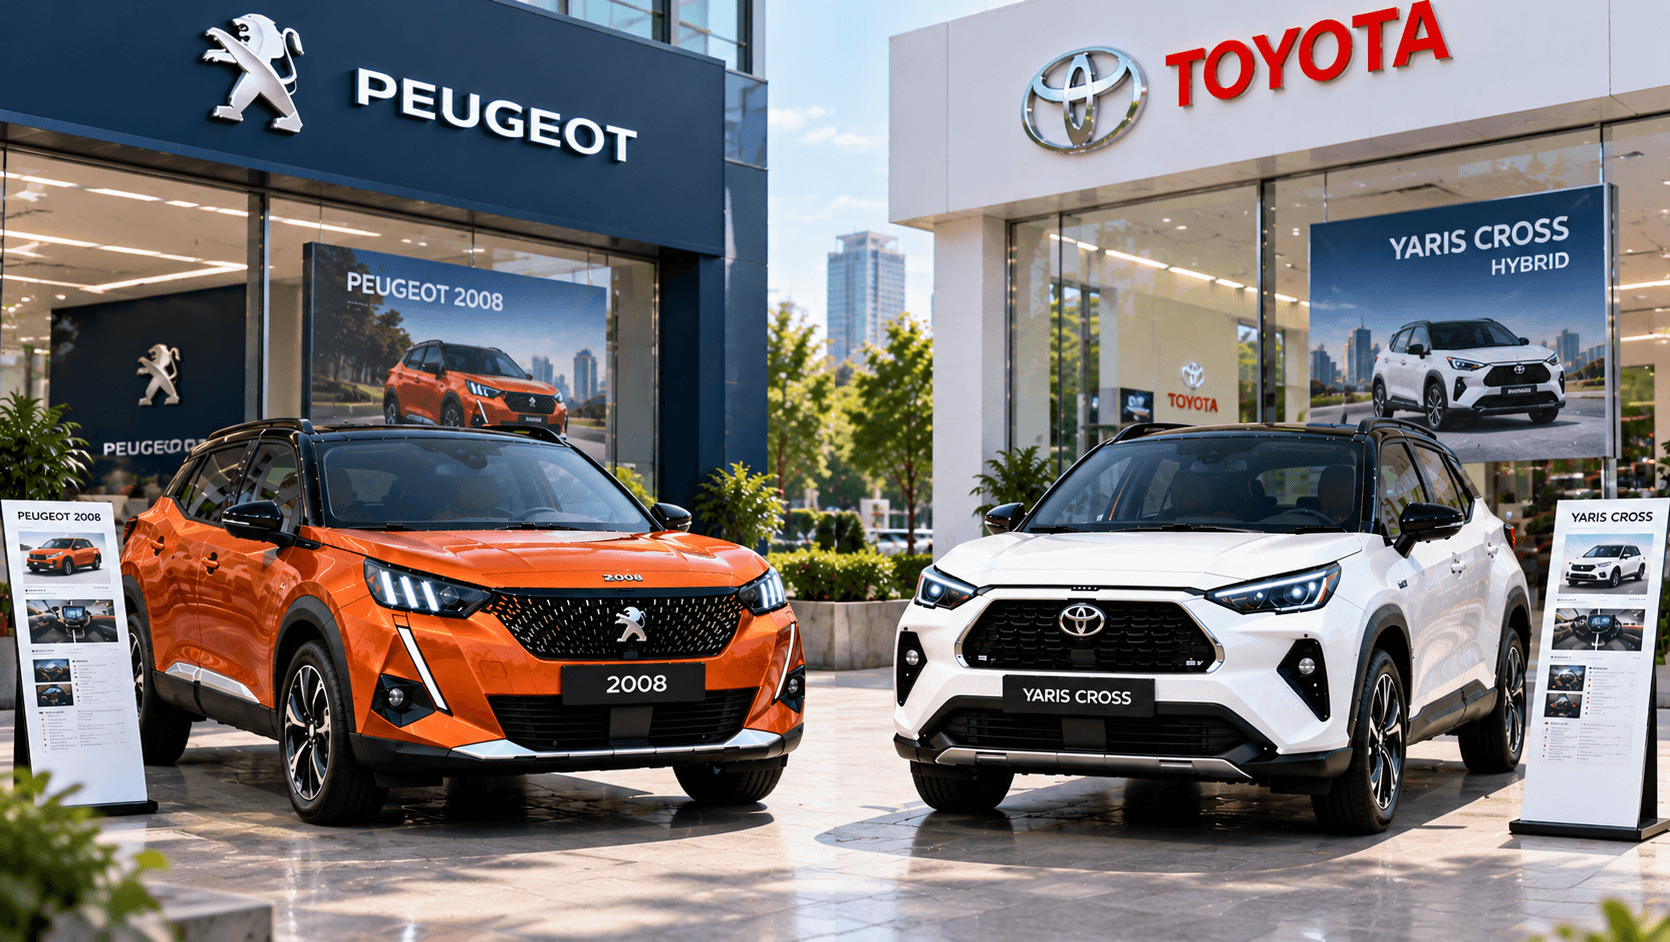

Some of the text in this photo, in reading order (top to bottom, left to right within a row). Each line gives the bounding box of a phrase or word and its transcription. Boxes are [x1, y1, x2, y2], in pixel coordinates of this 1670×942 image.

[1165, 0, 1453, 108] TOYOTA
[356, 67, 638, 163] PEUGEOT
[1389, 215, 1570, 260] YARIS CROSS
[1491, 251, 1570, 276] HYBRID
[347, 271, 504, 312] PEUGEOT 2008
[1167, 392, 1219, 413] TOYOTA
[17, 511, 101, 521] PEUGEOT 2008
[1571, 511, 1654, 522] YARIS CROSS
[606, 675, 667, 693] 2008
[1023, 688, 1131, 704] YARIS CROSS
